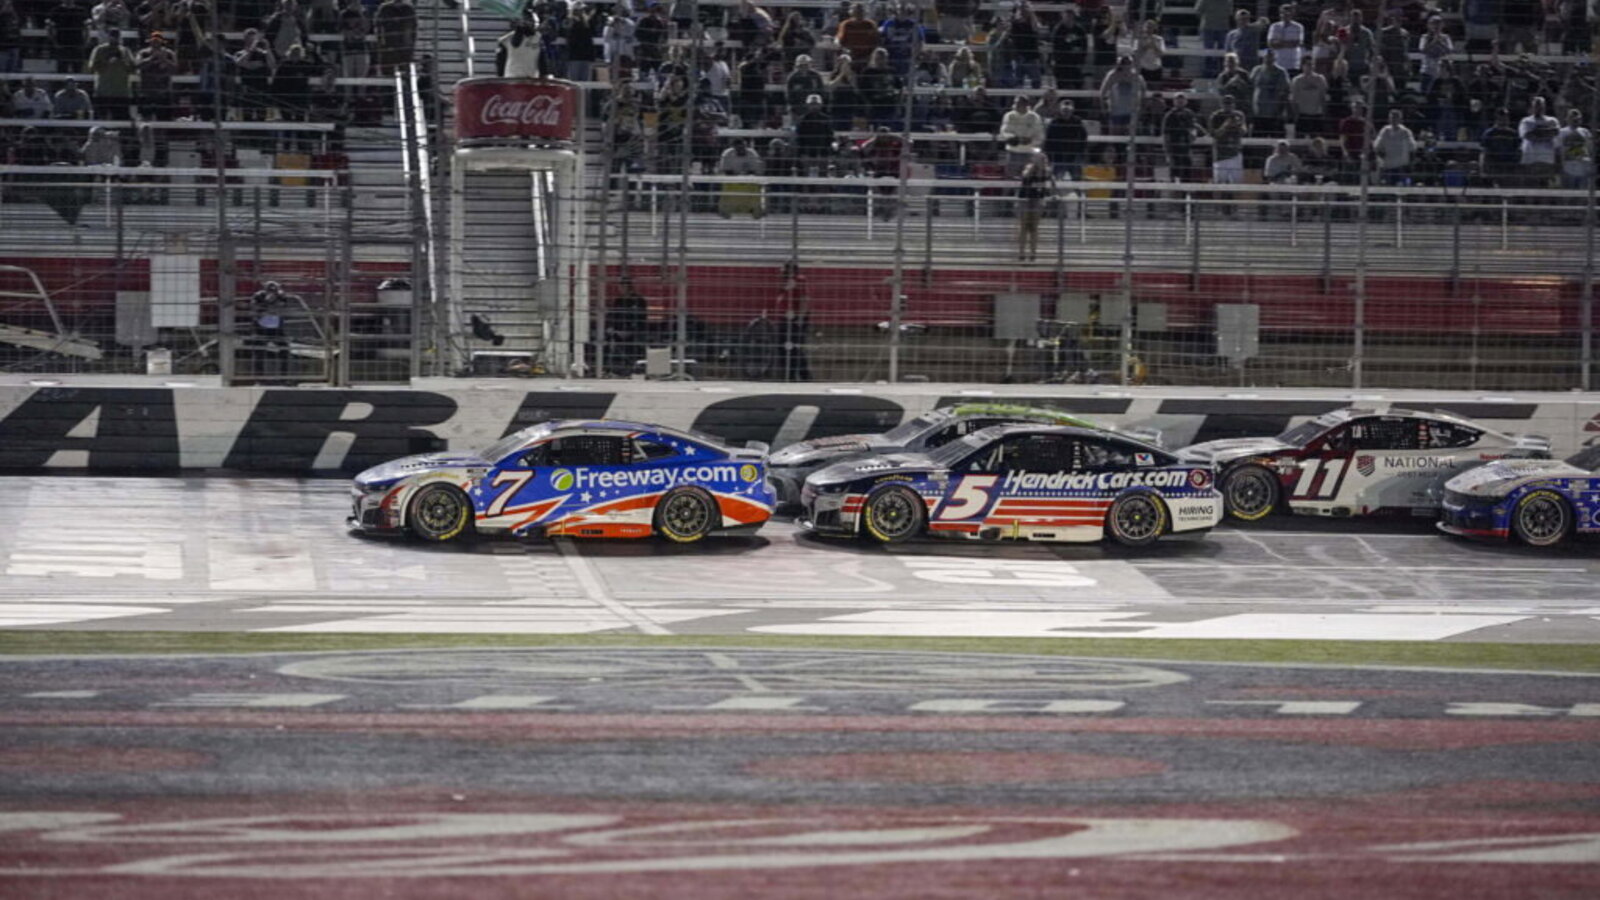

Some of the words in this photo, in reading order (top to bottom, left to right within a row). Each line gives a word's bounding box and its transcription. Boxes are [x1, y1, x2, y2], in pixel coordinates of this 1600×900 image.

[481, 94, 564, 125] Coca-Cola
[575, 466, 737, 488] Freeway.com
[1384, 457, 1455, 469] NATIONAL
[1002, 469, 1187, 494] HendrickCars.com
[1293, 458, 1345, 497] 11
[485, 470, 534, 517] 7
[940, 473, 998, 521] 5
[1178, 506, 1213, 516] HIRING
